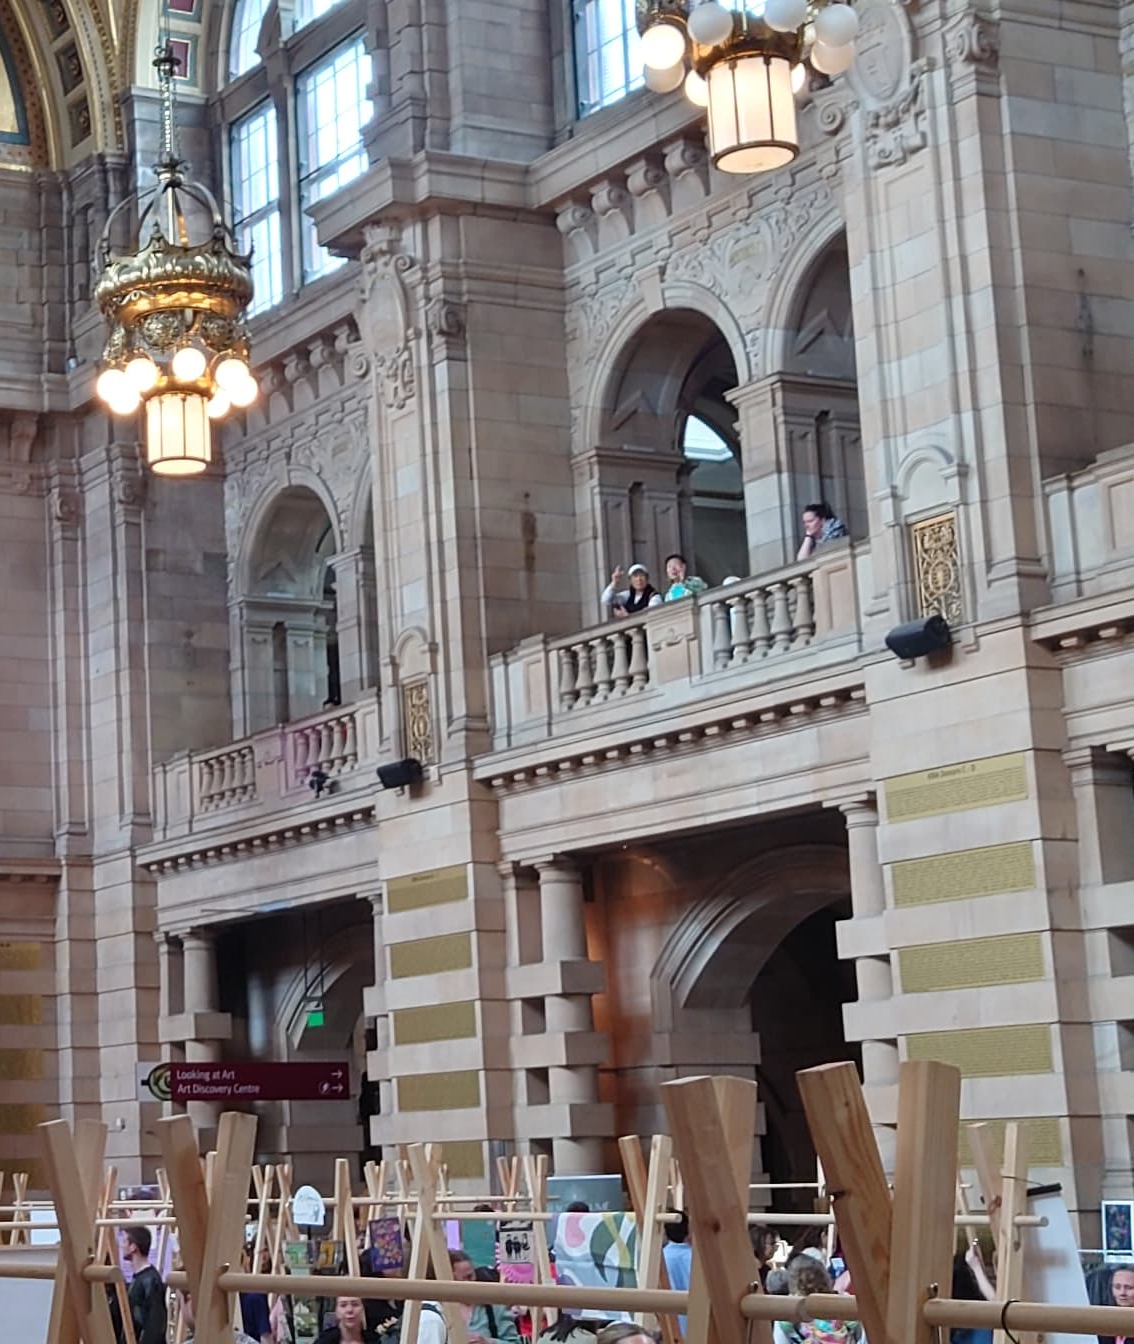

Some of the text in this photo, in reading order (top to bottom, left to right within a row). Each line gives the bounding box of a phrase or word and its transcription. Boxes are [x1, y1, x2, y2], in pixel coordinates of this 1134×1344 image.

[176, 1070, 235, 1082] Looking at Art
[177, 1084, 260, 1095] Art Discovery Centre
